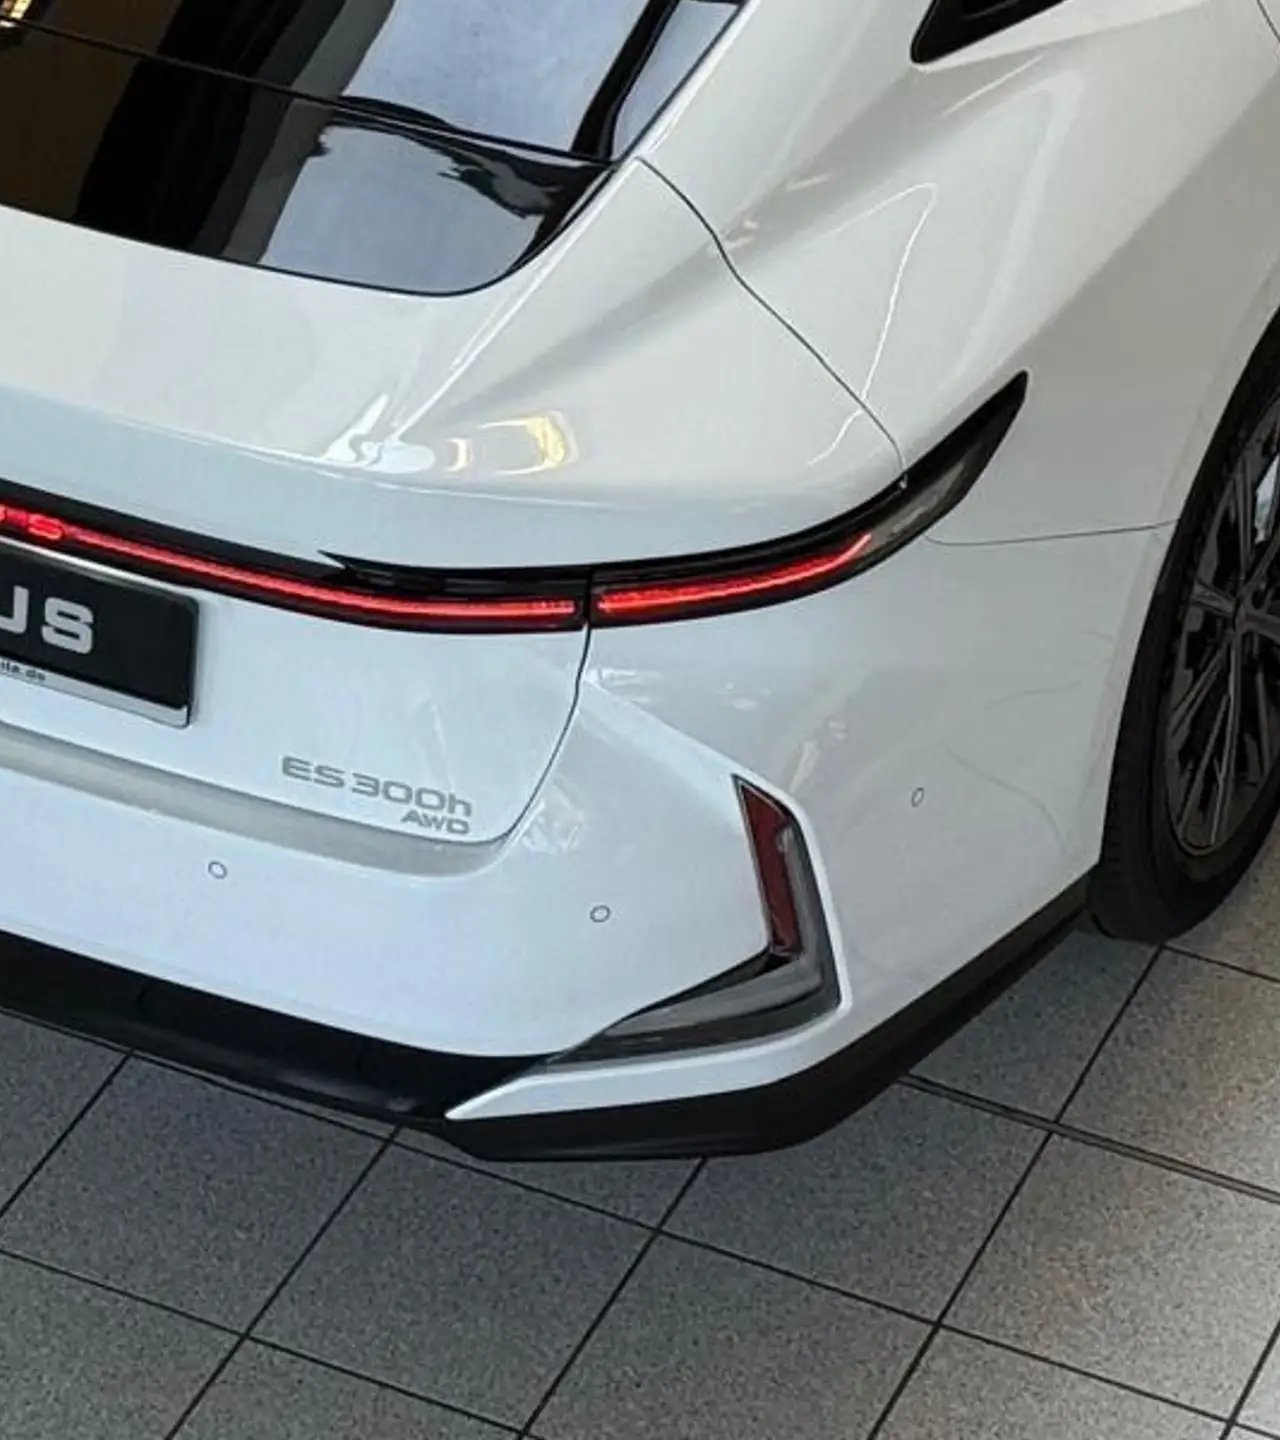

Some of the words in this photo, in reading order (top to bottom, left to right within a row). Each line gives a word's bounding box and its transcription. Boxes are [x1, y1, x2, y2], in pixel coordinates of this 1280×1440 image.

[281, 755, 347, 790] ES
[350, 771, 472, 817] 300h
[400, 809, 471, 835] AWD
